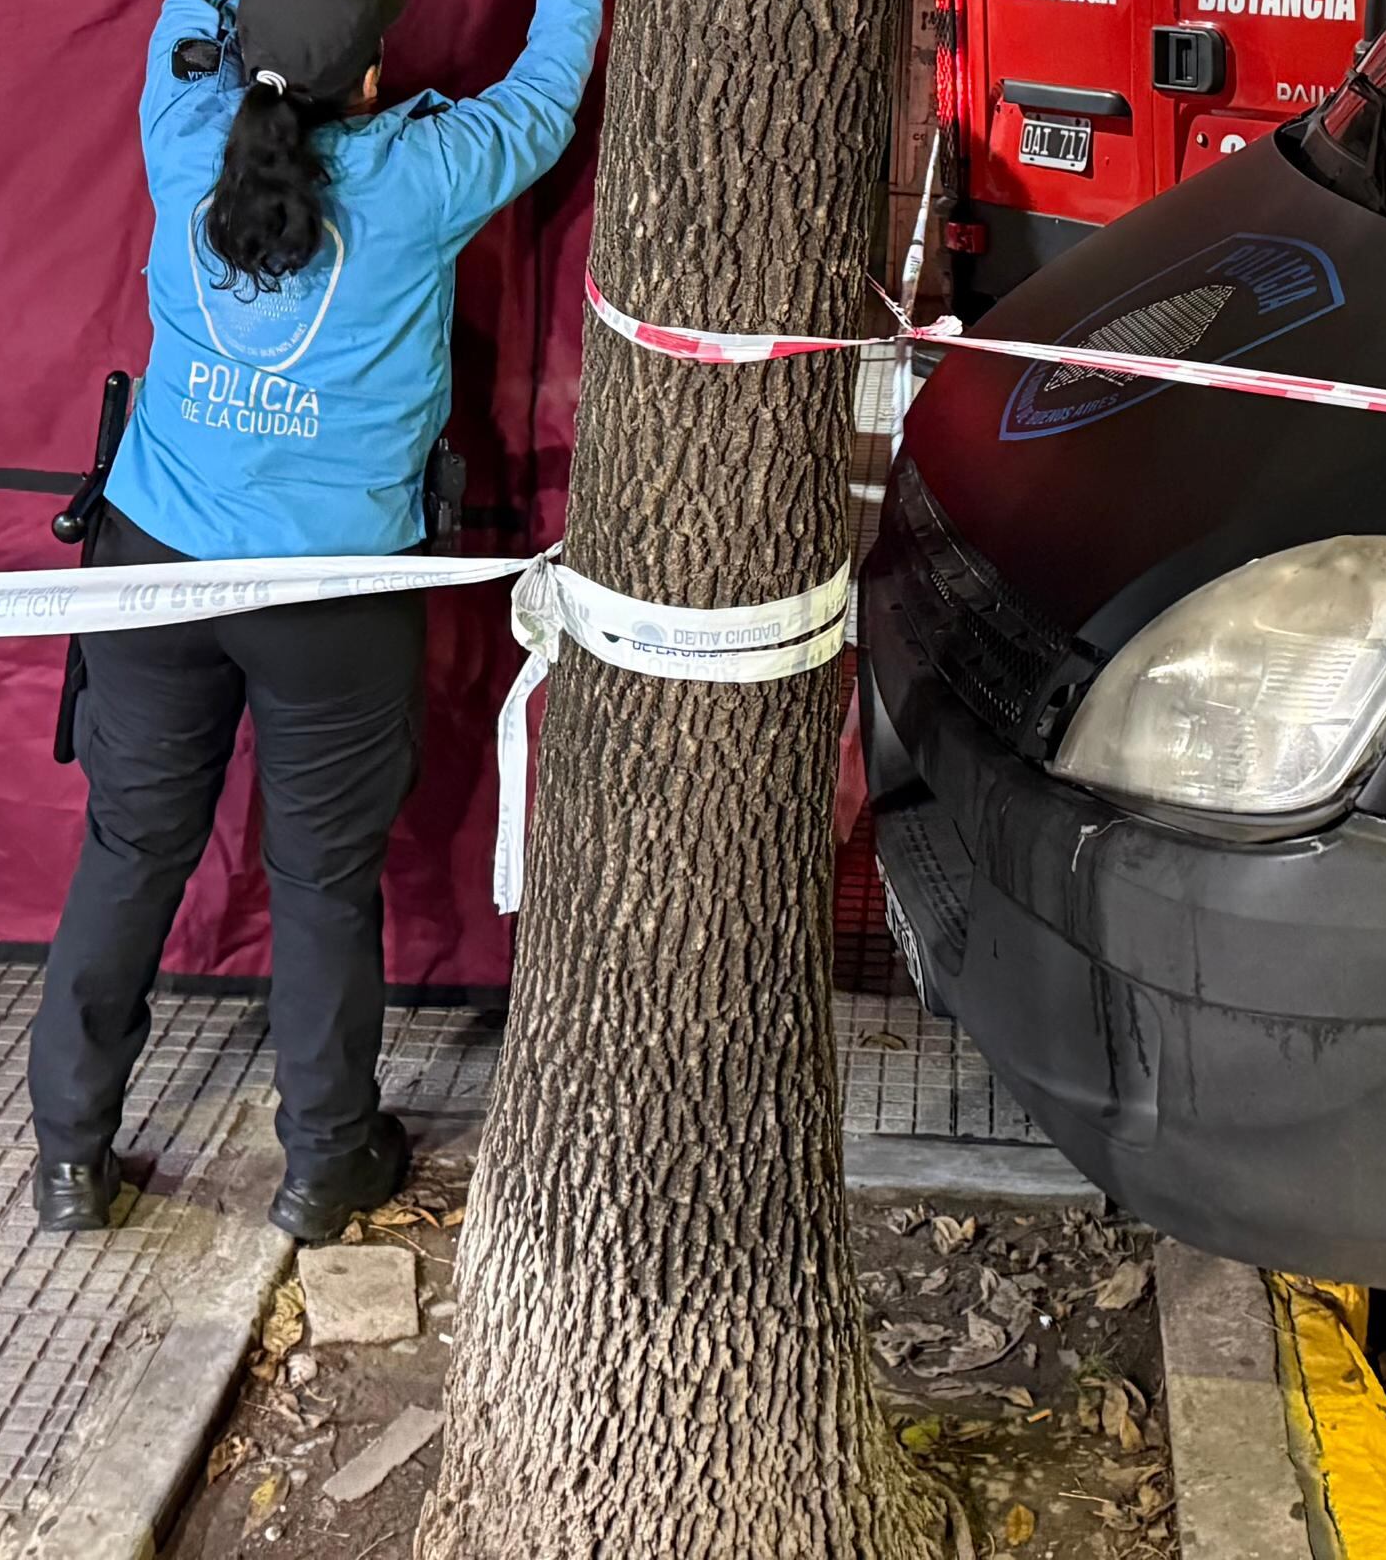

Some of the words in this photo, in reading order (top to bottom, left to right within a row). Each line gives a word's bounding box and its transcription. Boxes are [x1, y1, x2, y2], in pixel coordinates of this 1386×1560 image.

[1277, 82, 1338, 104] DAIL
[1022, 125, 1052, 155] OAI
[1059, 129, 1087, 161] 717
[1205, 245, 1317, 315] POLICIA
[188, 360, 319, 416] POLICIA
[181, 398, 201, 423] DE
[206, 404, 231, 430] LA
[237, 409, 319, 438] CIUDAD
